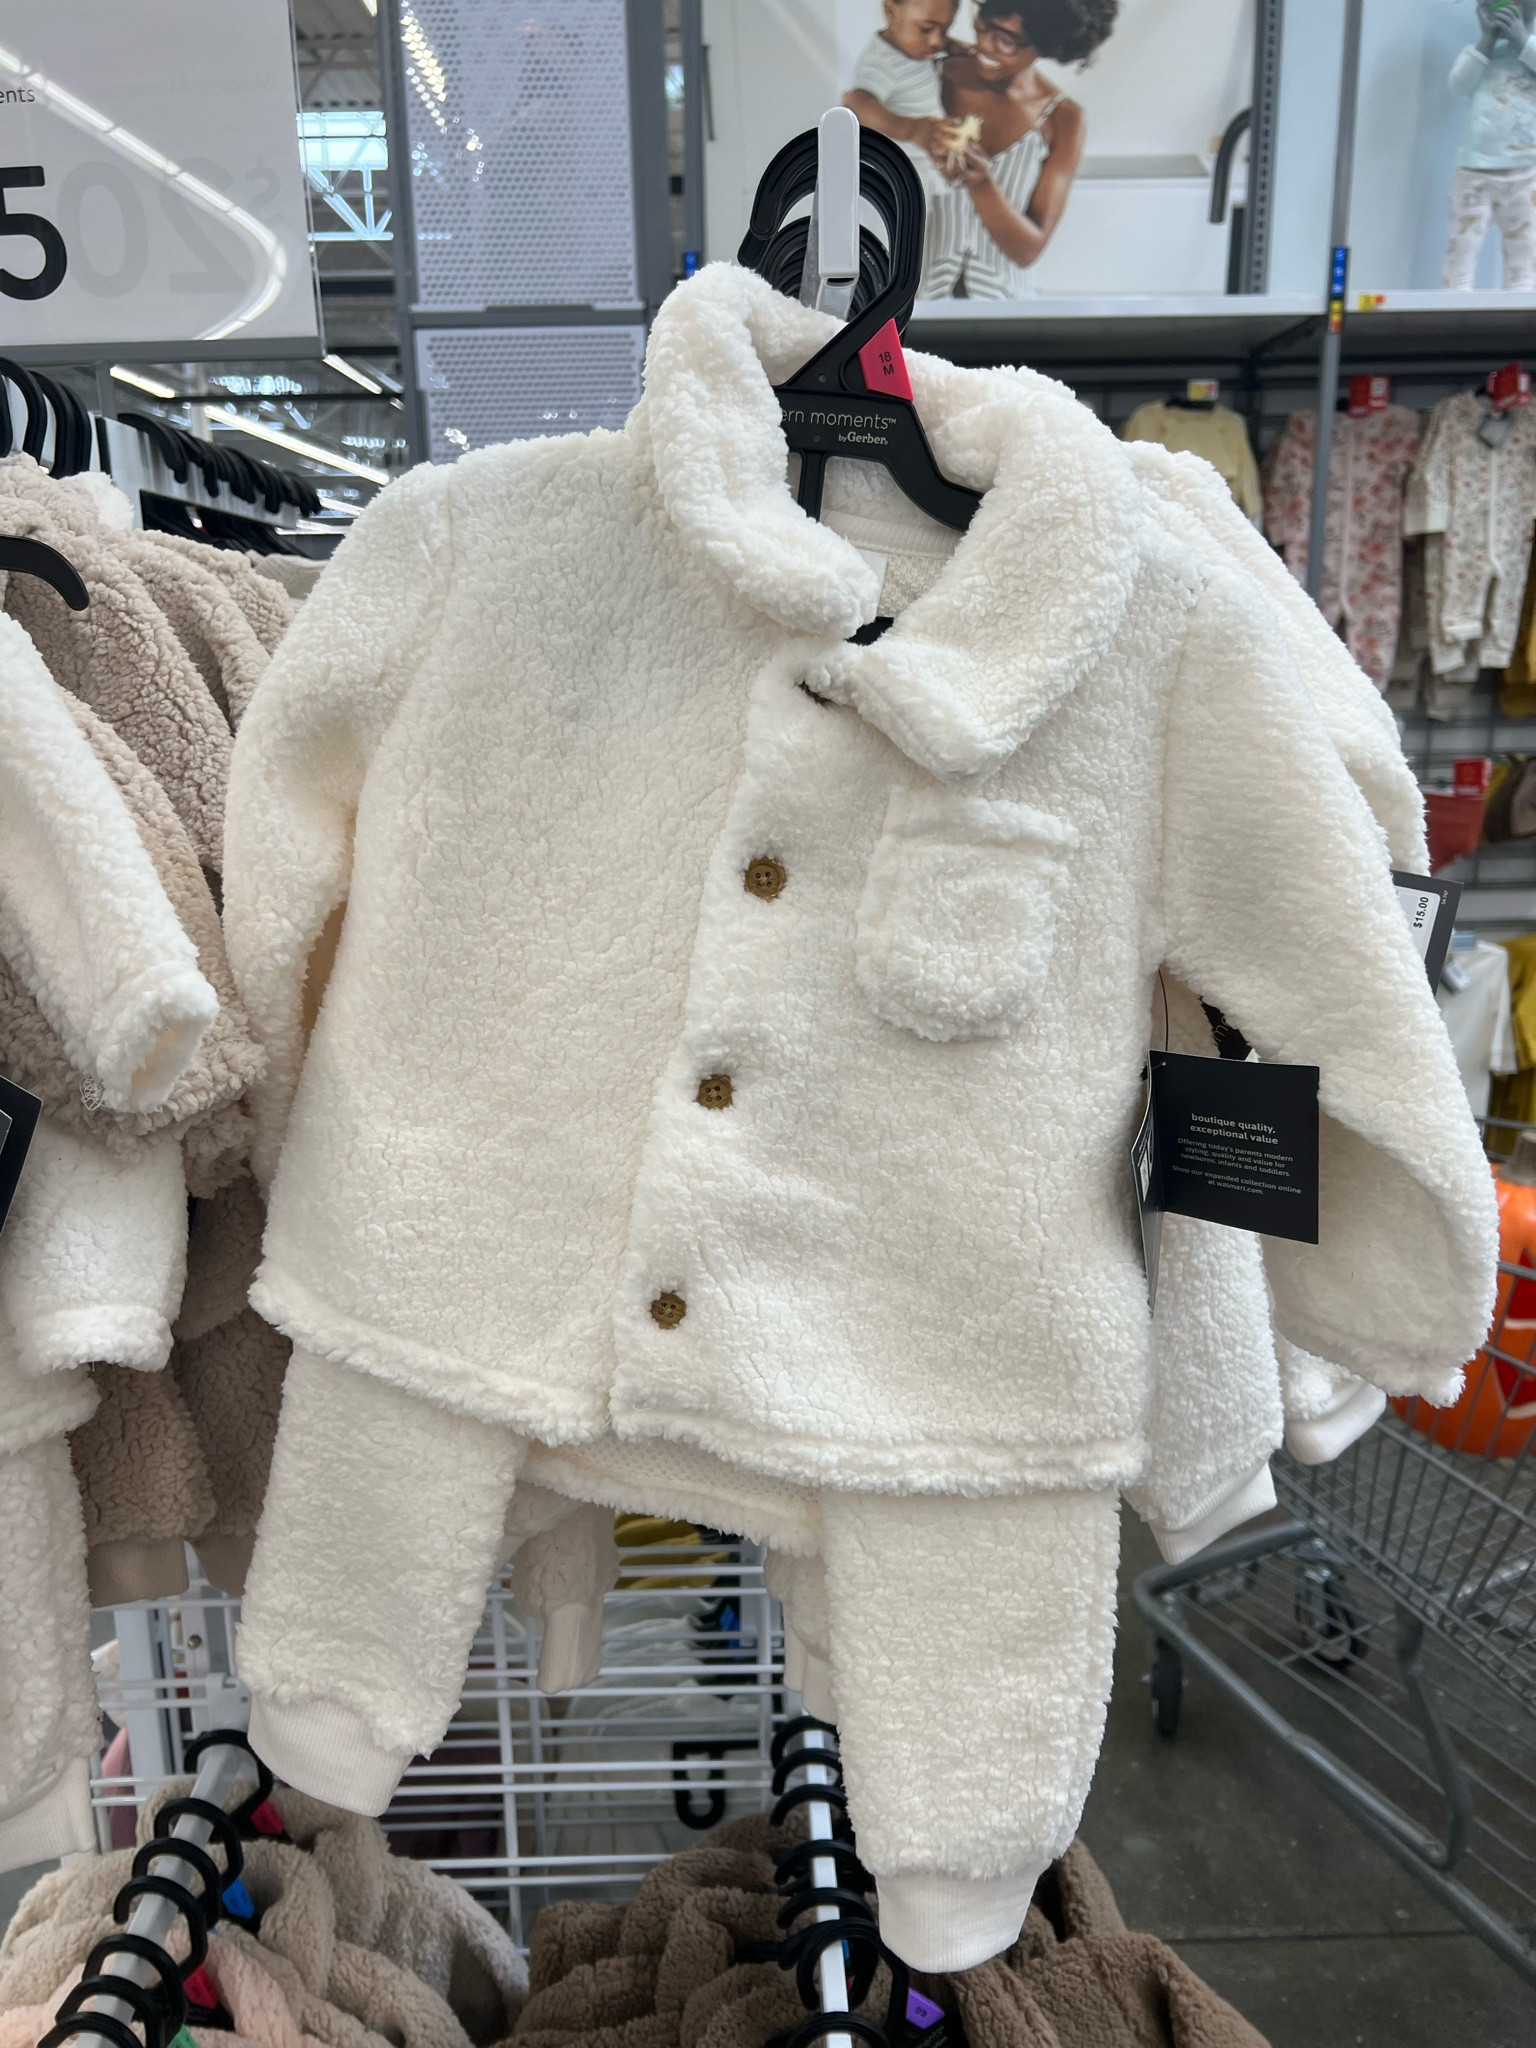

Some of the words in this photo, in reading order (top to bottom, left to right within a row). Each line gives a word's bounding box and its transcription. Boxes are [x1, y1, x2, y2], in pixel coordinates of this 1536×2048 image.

[878, 351, 892, 363] 18
[882, 363, 895, 376] M
[1413, 896, 1429, 928] $15.00
[1192, 1113, 1235, 1127] boutique
[1238, 1120, 1275, 1134] quality,
[1190, 1124, 1248, 1140] exceptional
[1250, 1134, 1278, 1144] value
[1178, 1138, 1206, 1148] Offering
[1208, 1141, 1233, 1152] today's
[1235, 1148, 1262, 1158] parents
[1264, 1150, 1293, 1161] modern
[1212, 1151, 1236, 1161] quality
[1253, 1158, 1272, 1166] value
[1275, 1160, 1285, 1168] for
[1218, 1159, 1242, 1169] infants
[1244, 1163, 1257, 1171] and
[1259, 1167, 1291, 1177] toddlers.
[1172, 1165, 1190, 1174] Shop
[1191, 1168, 1203, 1176] our
[1205, 1171, 1239, 1183] expanded
[1241, 1176, 1276, 1189] collection
[1278, 1185, 1301, 1194] online
